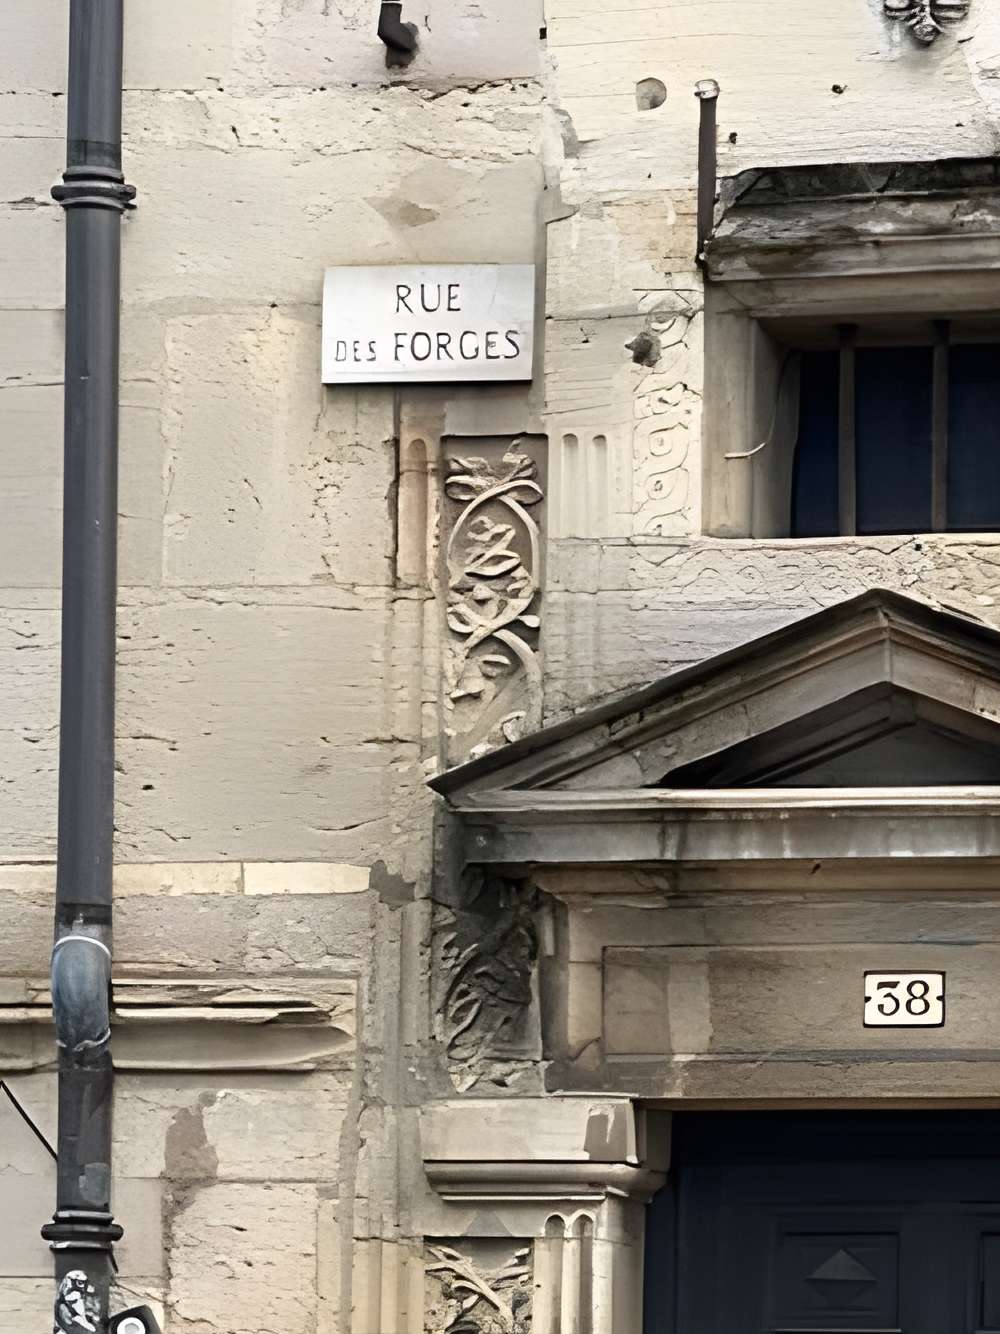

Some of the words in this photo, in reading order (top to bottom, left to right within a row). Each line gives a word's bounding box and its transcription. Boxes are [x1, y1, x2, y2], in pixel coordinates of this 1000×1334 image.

[396, 283, 461, 313] RUE
[335, 340, 377, 362] DES
[394, 330, 520, 362] FORGES
[877, 980, 930, 1016] 38
